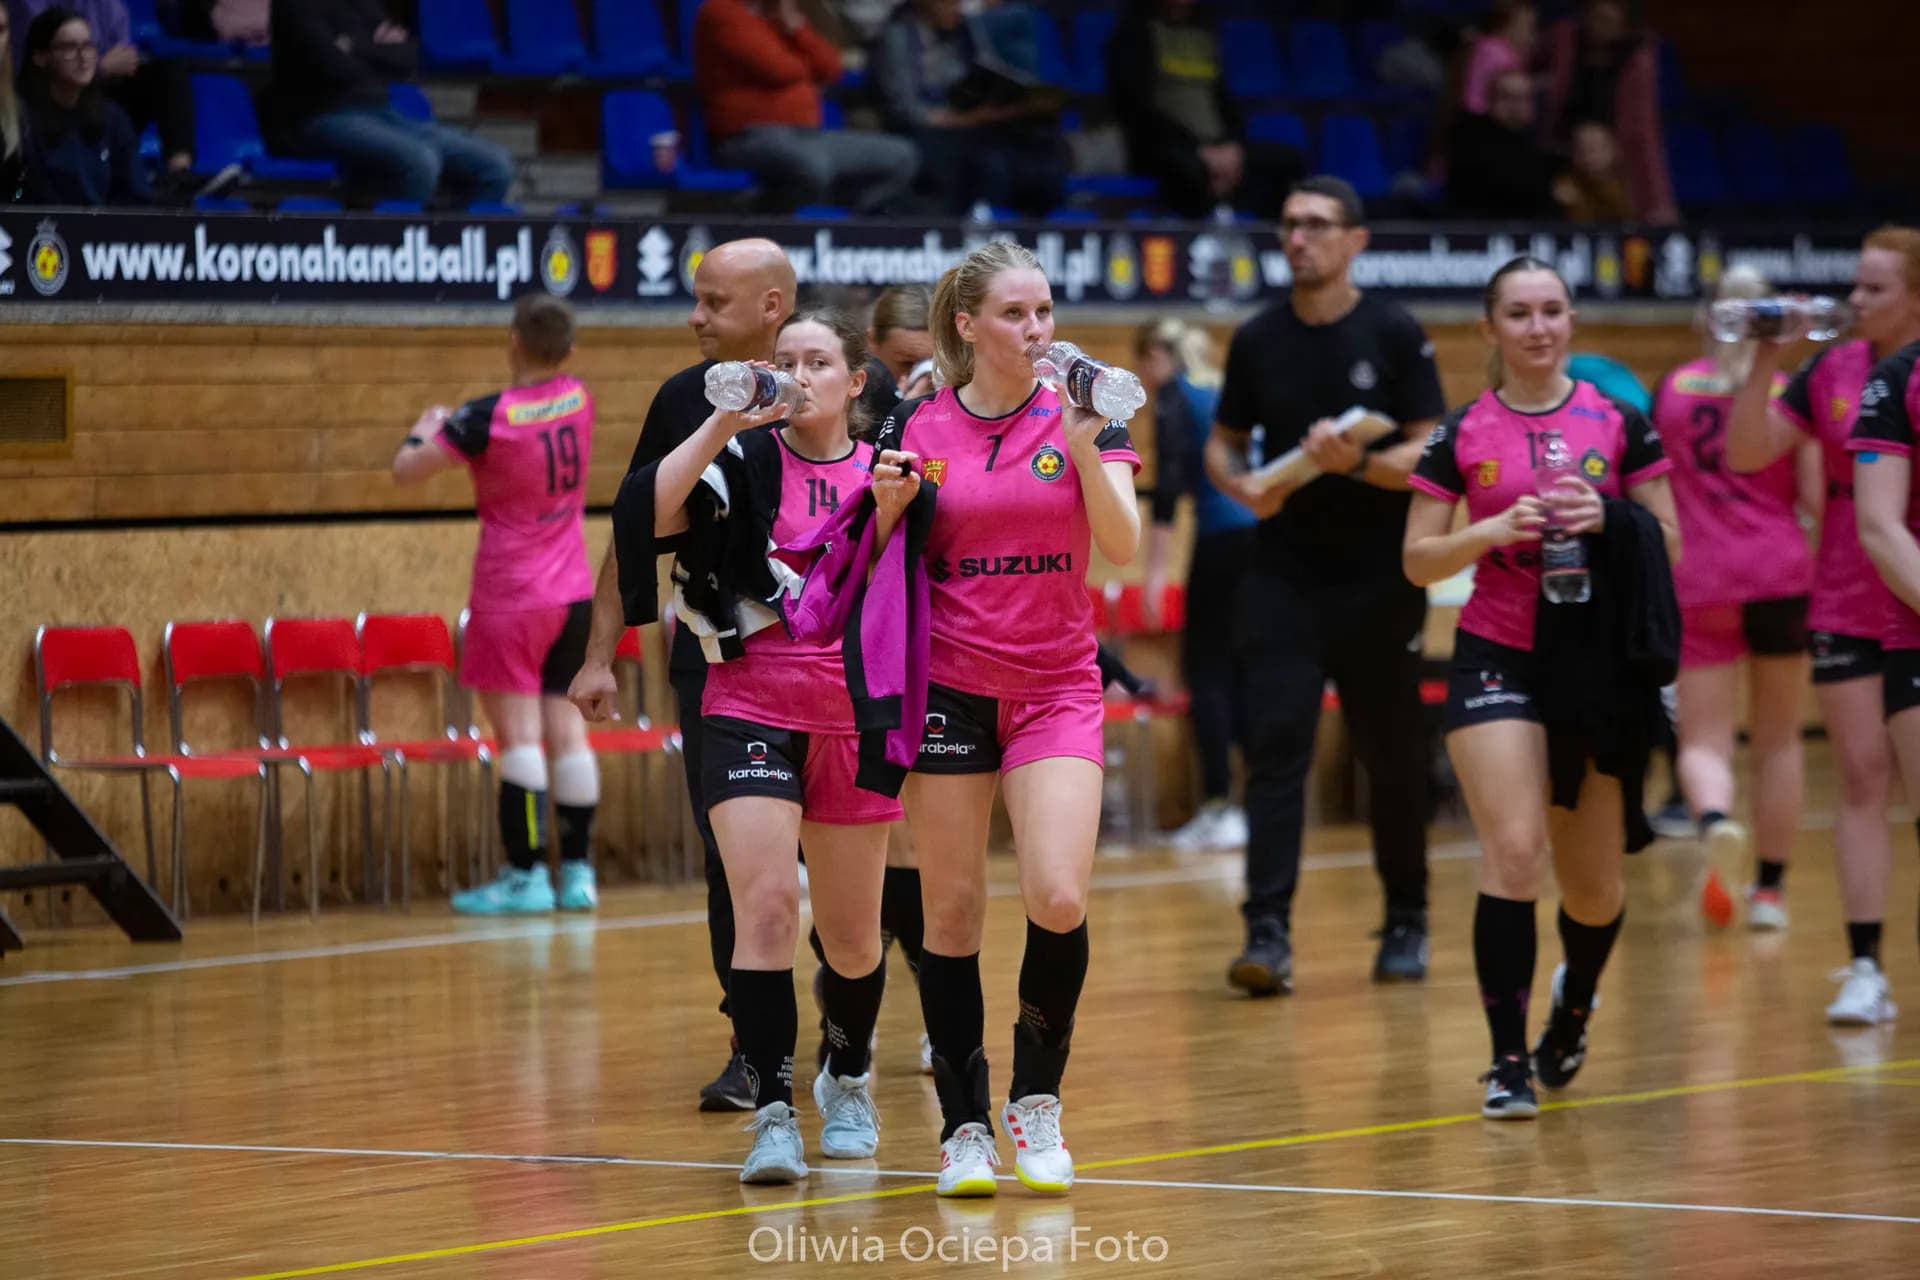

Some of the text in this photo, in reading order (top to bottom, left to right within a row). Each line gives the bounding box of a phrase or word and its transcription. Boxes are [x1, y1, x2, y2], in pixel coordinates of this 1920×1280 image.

[82, 223, 532, 299] www.koronahandball.pl
[539, 425, 580, 495] 19
[983, 433, 1003, 472] 7
[806, 479, 839, 517] 14
[958, 552, 1072, 577] SUZUKI
[919, 742, 968, 755] rabela
[728, 767, 788, 781] karabela
